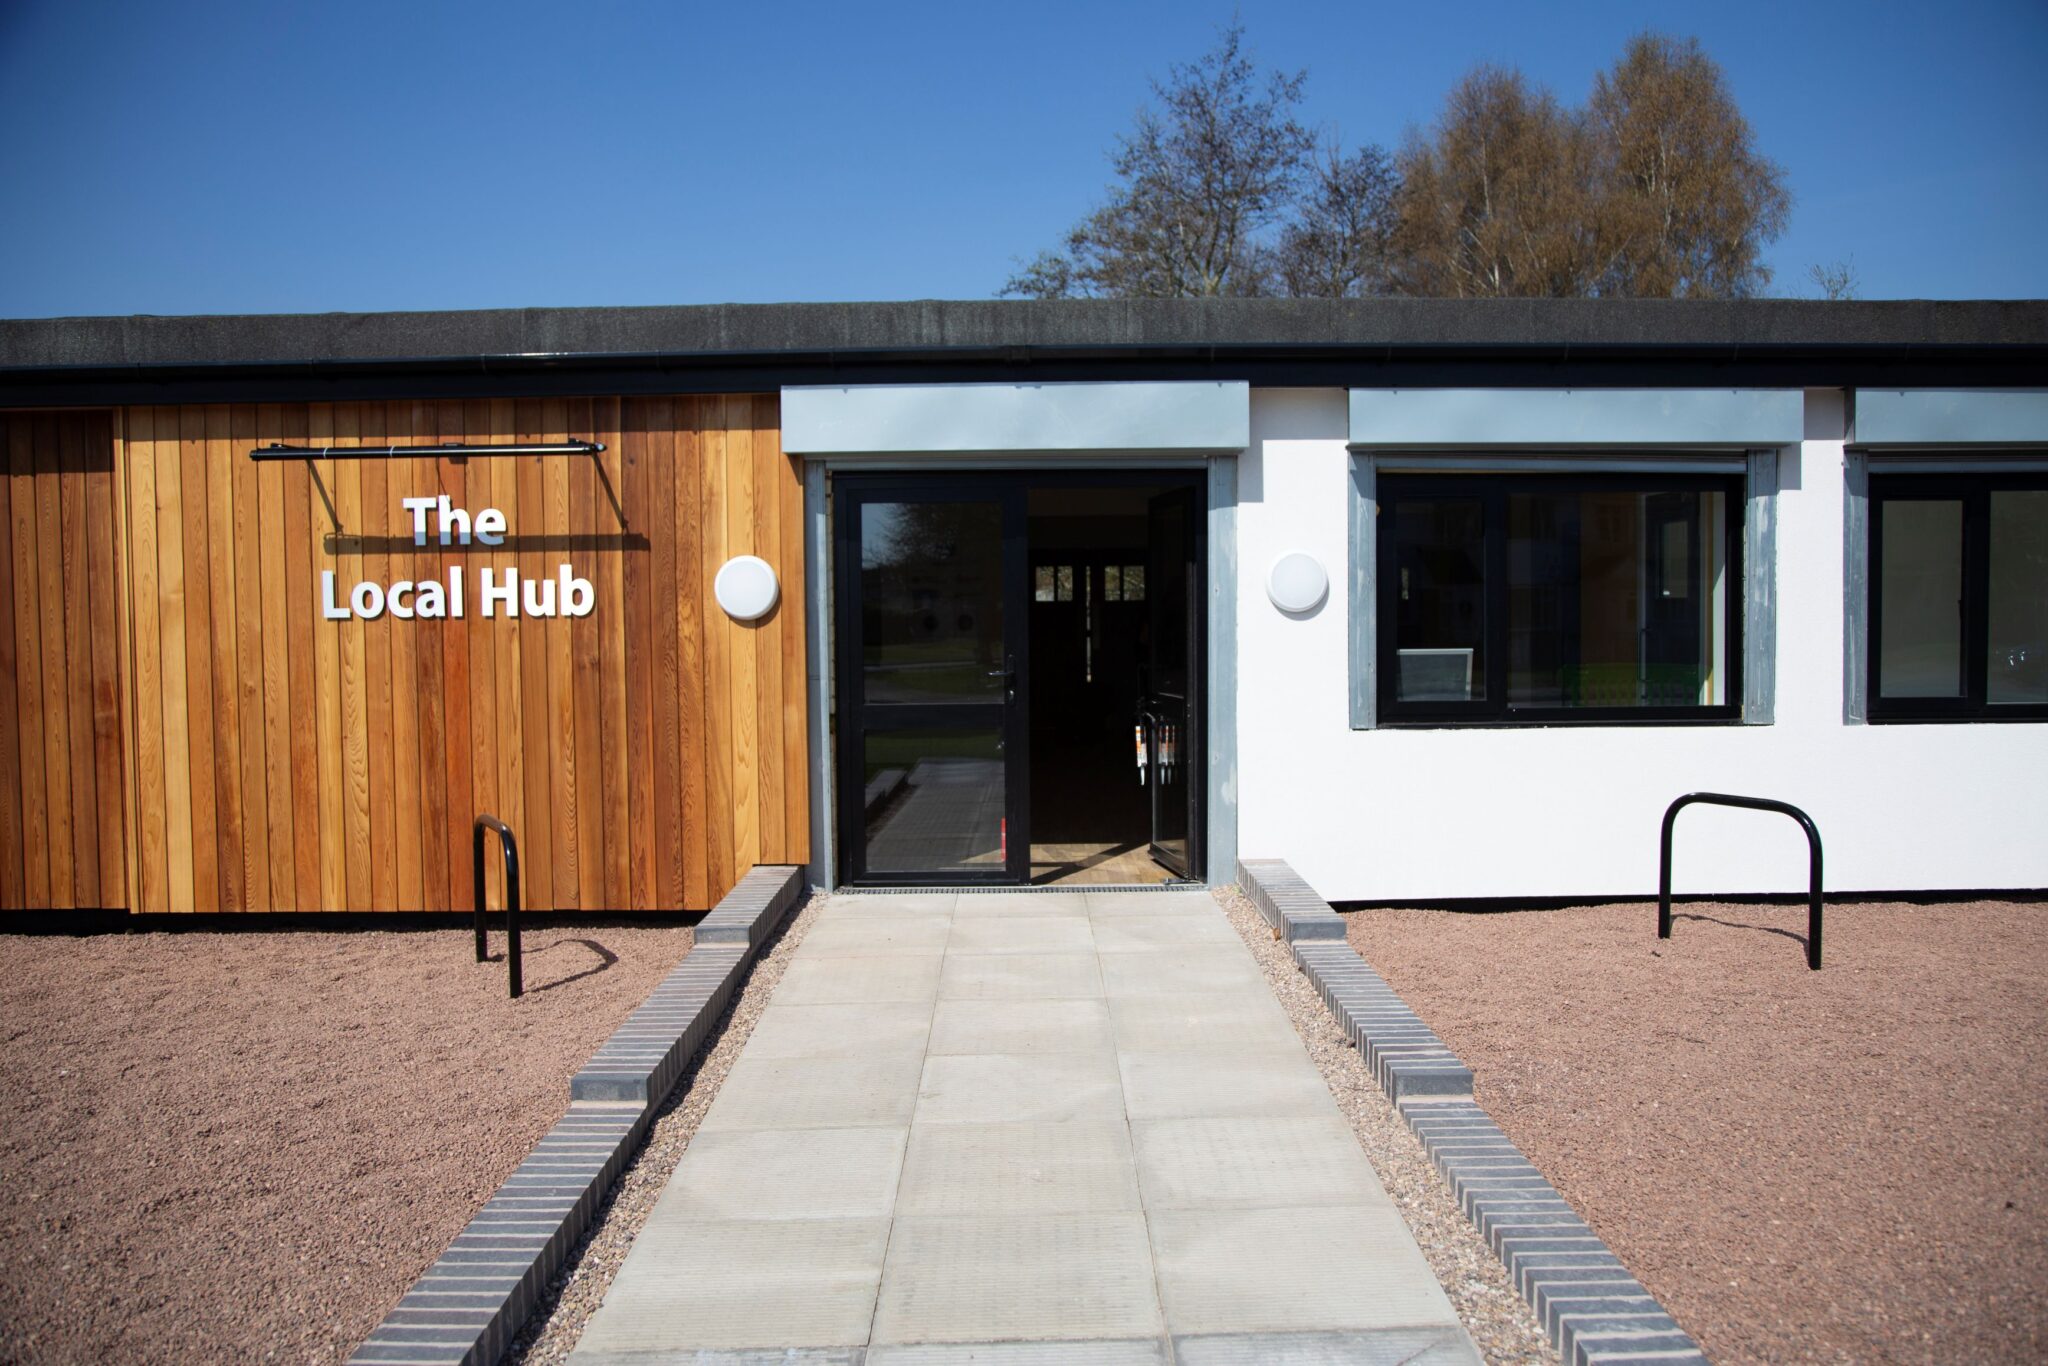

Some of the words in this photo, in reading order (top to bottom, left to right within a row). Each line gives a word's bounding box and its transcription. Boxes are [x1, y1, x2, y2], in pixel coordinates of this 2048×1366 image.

[403, 495, 507, 546] The
[322, 566, 463, 618] Local
[481, 564, 595, 617] Hub
